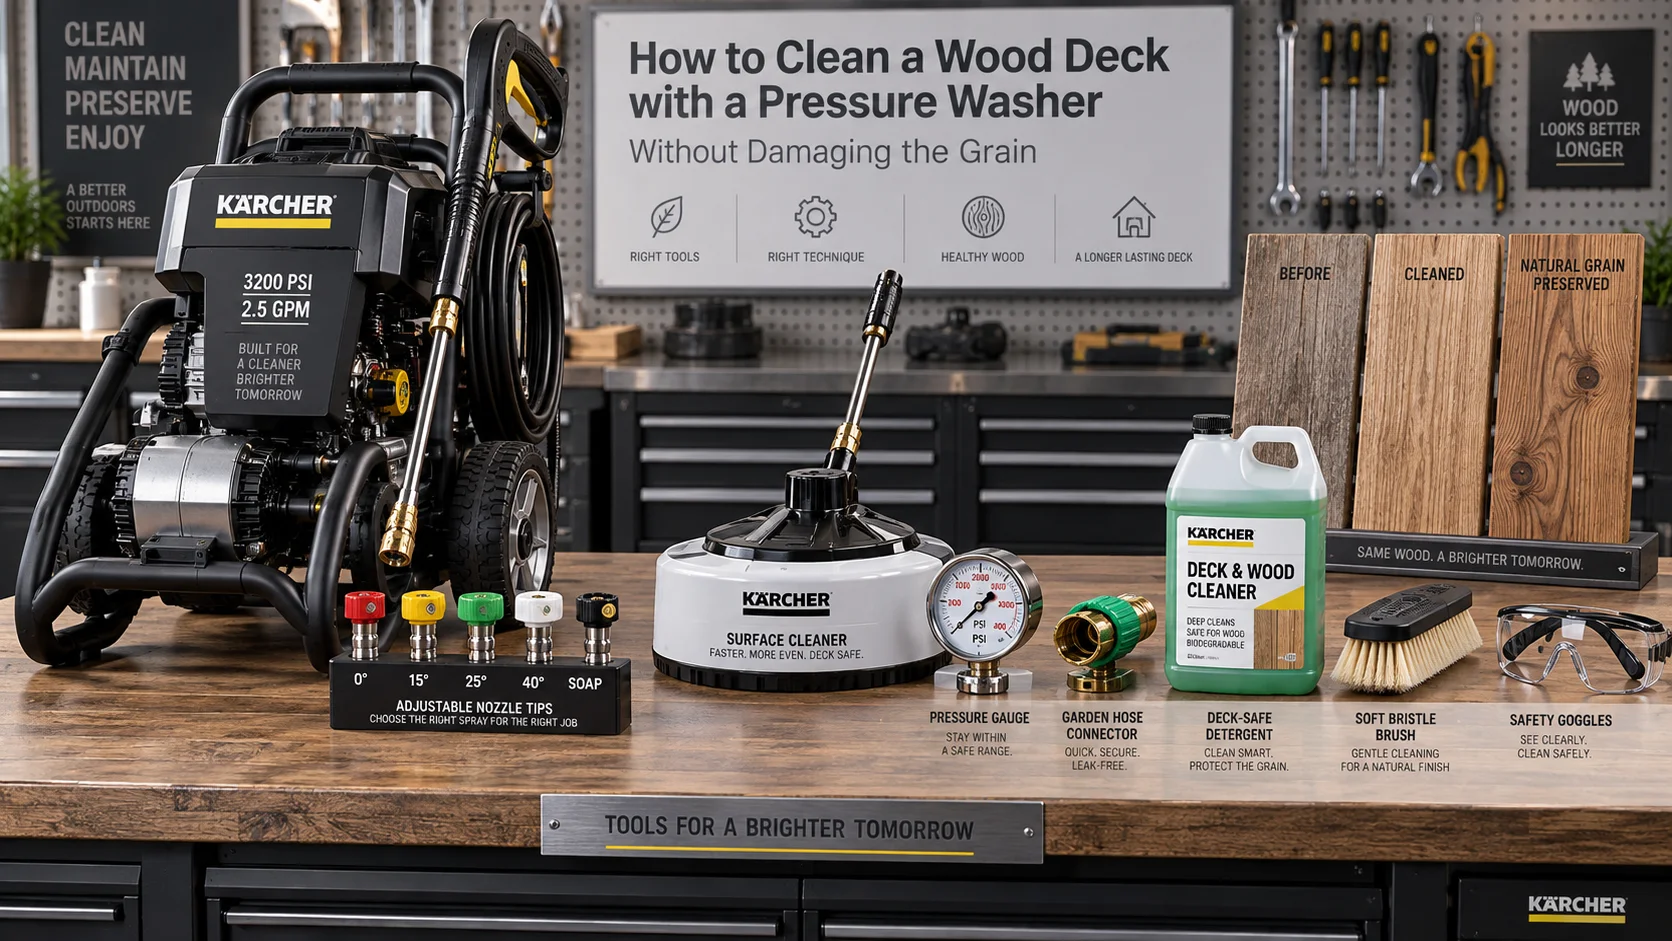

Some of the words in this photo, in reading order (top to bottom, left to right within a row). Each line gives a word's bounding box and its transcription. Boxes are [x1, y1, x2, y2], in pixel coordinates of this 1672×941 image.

[65, 21, 144, 46] CLEAN
[631, 42, 716, 74] How
[726, 43, 765, 74] to
[777, 40, 888, 74] Clean
[902, 47, 923, 73] a
[935, 38, 1051, 73] Wood
[1066, 37, 1170, 72] Deck
[66, 56, 185, 80] MAINTAIN
[66, 90, 192, 115] PRESERVE
[629, 84, 712, 118] with
[725, 93, 746, 118] a
[760, 85, 937, 118] Pressure
[947, 83, 1102, 118] Washer
[1563, 100, 1618, 116] WOOD
[1541, 122, 1584, 136] LOOKS
[1590, 122, 1640, 135] BETTER
[67, 125, 145, 149] ENJOY
[630, 139, 738, 163] Without
[749, 139, 890, 169] Damaging
[902, 139, 948, 163] the
[960, 138, 1036, 163] Grain
[1557, 142, 1623, 157] LONGER
[67, 184, 75, 195] A
[80, 184, 126, 196] BETTER
[67, 200, 135, 212] OUTDOORS
[217, 195, 333, 214] KÄRCHER
[67, 217, 113, 228] STARTS
[118, 217, 150, 229] HERE
[631, 252, 662, 261] RIGHT
[665, 252, 699, 262] TOOLS
[769, 252, 799, 261] RIGHT
[804, 252, 864, 263] TECHNIQUE
[942, 252, 988, 262] HEALTHY
[992, 252, 1024, 262] WOOD
[1075, 253, 1082, 261] A
[1085, 252, 1122, 262] LONGER
[1126, 252, 1165, 262] LASTING
[1168, 252, 1192, 262] DECK
[1521, 259, 1580, 272] NATURAL
[1585, 259, 1624, 272] GRAIN
[1280, 267, 1331, 281] BEFORE
[1405, 267, 1464, 280] CLEANED
[244, 274, 282, 290] 3200
[288, 274, 312, 290] PSI
[1534, 277, 1609, 290] PRESERVED
[242, 300, 266, 317] 2.5
[273, 300, 309, 318] GPM
[239, 343, 272, 354] BUILT
[276, 344, 298, 354] FOR
[237, 358, 244, 368] A
[249, 358, 301, 370] CLEANER
[237, 373, 294, 385] BRIGHTER
[235, 389, 302, 400] TOMORROW
[1188, 527, 1254, 540] KÄRCHER
[1357, 546, 1391, 559] SAME
[1394, 548, 1434, 562] WOOD.
[1437, 549, 1446, 562] A
[1449, 551, 1508, 567] BRIGHTER
[1511, 554, 1584, 571] TOMORROW.
[1188, 562, 1227, 578] DECK
[1232, 563, 1242, 578] &
[1247, 564, 1294, 579] WOOD
[1188, 582, 1256, 599] CLEANER
[743, 592, 829, 606] KÄRCHER
[974, 620, 985, 629] PSI
[1187, 617, 1205, 625] DEEP
[1207, 618, 1235, 626] CLEANS
[973, 634, 986, 643] PSI
[1207, 629, 1220, 637] FOR
[727, 633, 784, 646] SURFACE
[789, 634, 846, 646] CLEANER
[1187, 639, 1244, 649] BIODEGRADABLE
[710, 648, 746, 658] FASTER.
[750, 650, 776, 659] MORE
[780, 650, 807, 659] EVEN.
[810, 650, 834, 659] DECK
[838, 650, 864, 659] SAFE.
[355, 673, 367, 685] 0°
[409, 674, 428, 686] 15°
[466, 675, 486, 687] 25°
[523, 676, 544, 688] 40°
[569, 677, 602, 689] SOAP
[396, 700, 472, 712] ADJUSTABLE
[477, 702, 522, 714] NOZZLE
[526, 703, 552, 714] TIPS
[370, 714, 406, 723] CHOOSE
[409, 715, 426, 724] THE
[430, 715, 456, 724] RIGHT
[459, 716, 488, 725] SPRAY
[491, 717, 508, 725] FOR
[511, 717, 527, 726] THE
[531, 717, 557, 726] RIGHT
[560, 718, 577, 727] JOB
[930, 712, 988, 723] PRESSURE
[992, 712, 1029, 723] GAUGE
[1063, 711, 1108, 723] GARDEN
[1114, 712, 1143, 723] HOSE
[1208, 712, 1272, 724] DECK-SAFE
[1356, 713, 1385, 724] SOFT
[1389, 713, 1436, 724] BRISTLE
[1510, 714, 1554, 726] SAFETY
[1558, 715, 1612, 726] GOGGLES
[946, 732, 969, 742] STAY
[973, 733, 1006, 742] WITHIN
[1067, 728, 1137, 739] CONNECTOR
[1207, 729, 1273, 740] DETERGENT
[1376, 729, 1415, 741] BRUSH
[1521, 735, 1538, 744] SEE
[1542, 735, 1588, 744] CLEARLY.
[942, 746, 948, 755] A
[951, 746, 974, 755] SAFE
[978, 746, 1013, 755] RANGE.
[1065, 747, 1097, 757] QUICK.
[1100, 747, 1140, 757] SECURE.
[1205, 748, 1235, 757] CLEAN
[1239, 748, 1274, 757] SMART.
[1352, 749, 1388, 758] GENTLE
[1392, 749, 1439, 758] CLEANING
[1518, 749, 1550, 758] CLEAN
[1553, 749, 1592, 758] SAFELY.
[1073, 760, 1127, 770] LEAK-FREE.
[1190, 761, 1233, 771] PROTECT
[1236, 761, 1253, 771] THE
[1257, 762, 1289, 771] GRAIN.
[1341, 762, 1359, 771] FOR
[1362, 763, 1369, 771] A
[1372, 762, 1415, 771] NATURAL
[1419, 762, 1449, 772] FINISH
[605, 815, 667, 834] TOOLS
[677, 817, 714, 835] FOR
[724, 818, 736, 836] A
[747, 818, 844, 838] BRIGHTER
[854, 820, 974, 840] TOMORROW
[1529, 896, 1625, 912] KÄRCHER
